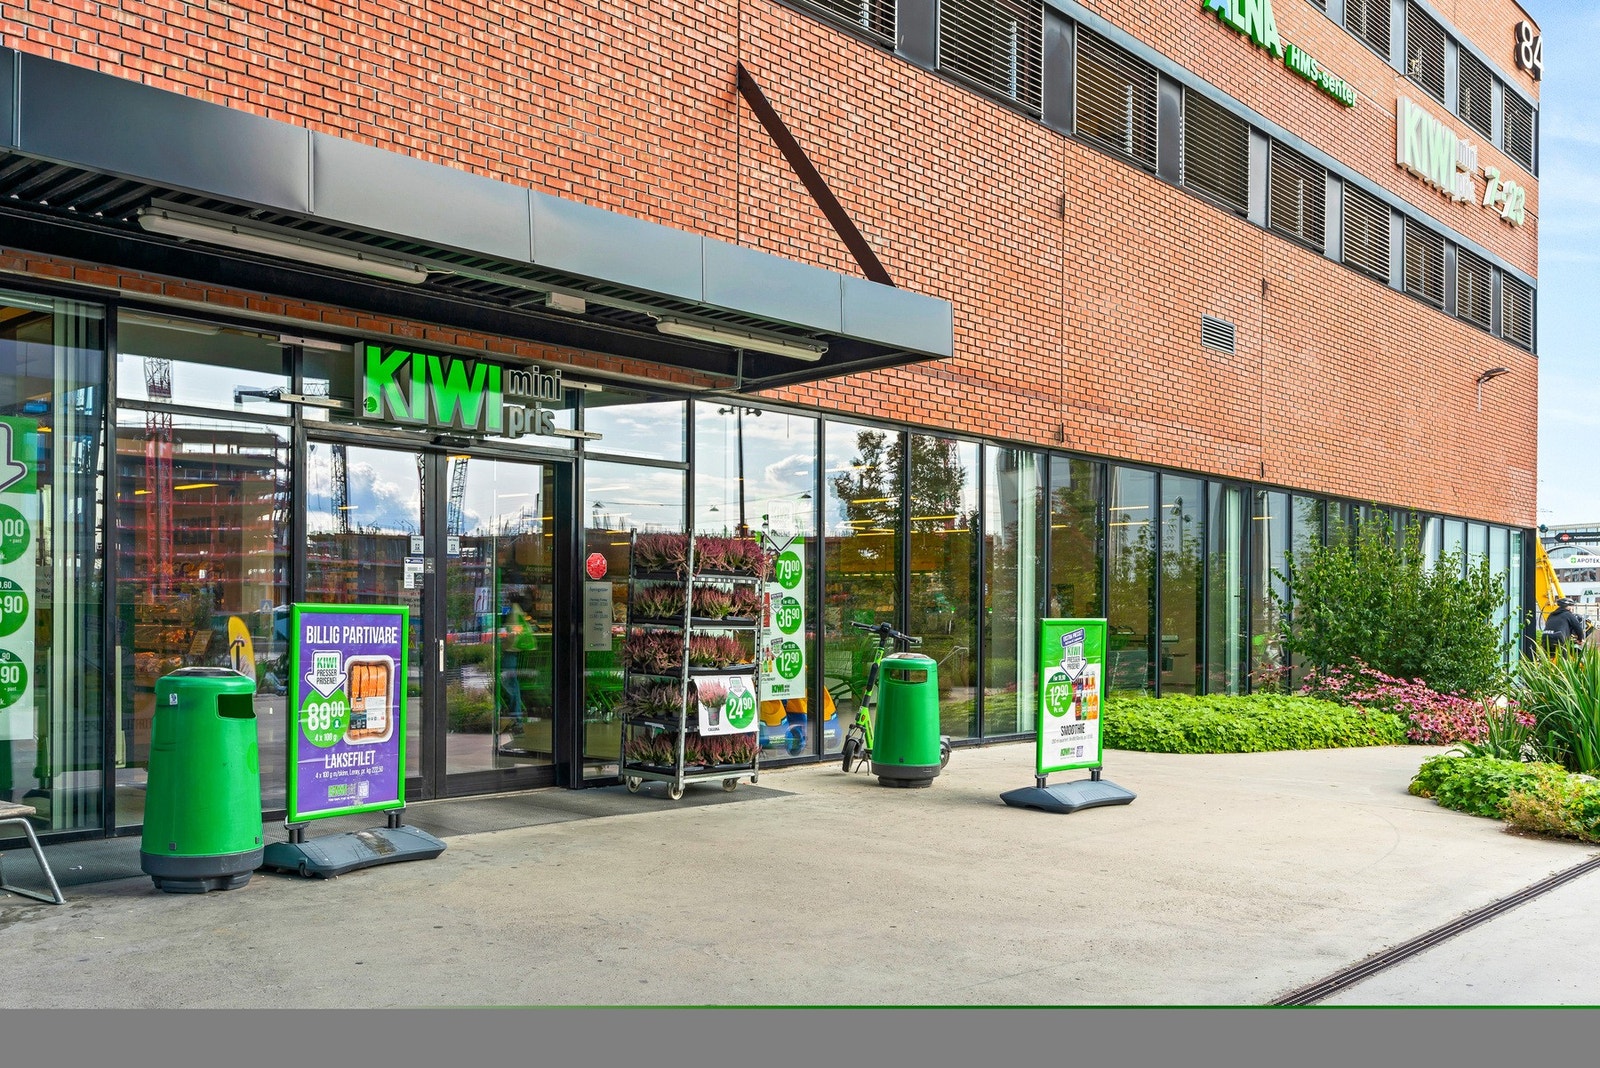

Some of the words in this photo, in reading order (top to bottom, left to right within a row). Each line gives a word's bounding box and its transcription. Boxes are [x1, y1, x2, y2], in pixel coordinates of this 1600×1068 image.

[1520, 20, 1544, 82] 84
[1286, 45, 1357, 107] HMS-senter
[1398, 96, 1457, 197] KIWI
[1484, 166, 1526, 227] 7-23
[363, 345, 503, 434] KIWI
[508, 365, 562, 401] mini
[509, 402, 556, 438] pris
[306, 625, 340, 644] BILLIG
[342, 626, 398, 644] PARTIVARE
[316, 657, 337, 668] KIWI
[316, 668, 337, 677] PRESSER
[314, 733, 319, 742] 4
[1060, 722, 1086, 737] SMOOTHIE
[325, 750, 377, 769] LAKSEFILET
